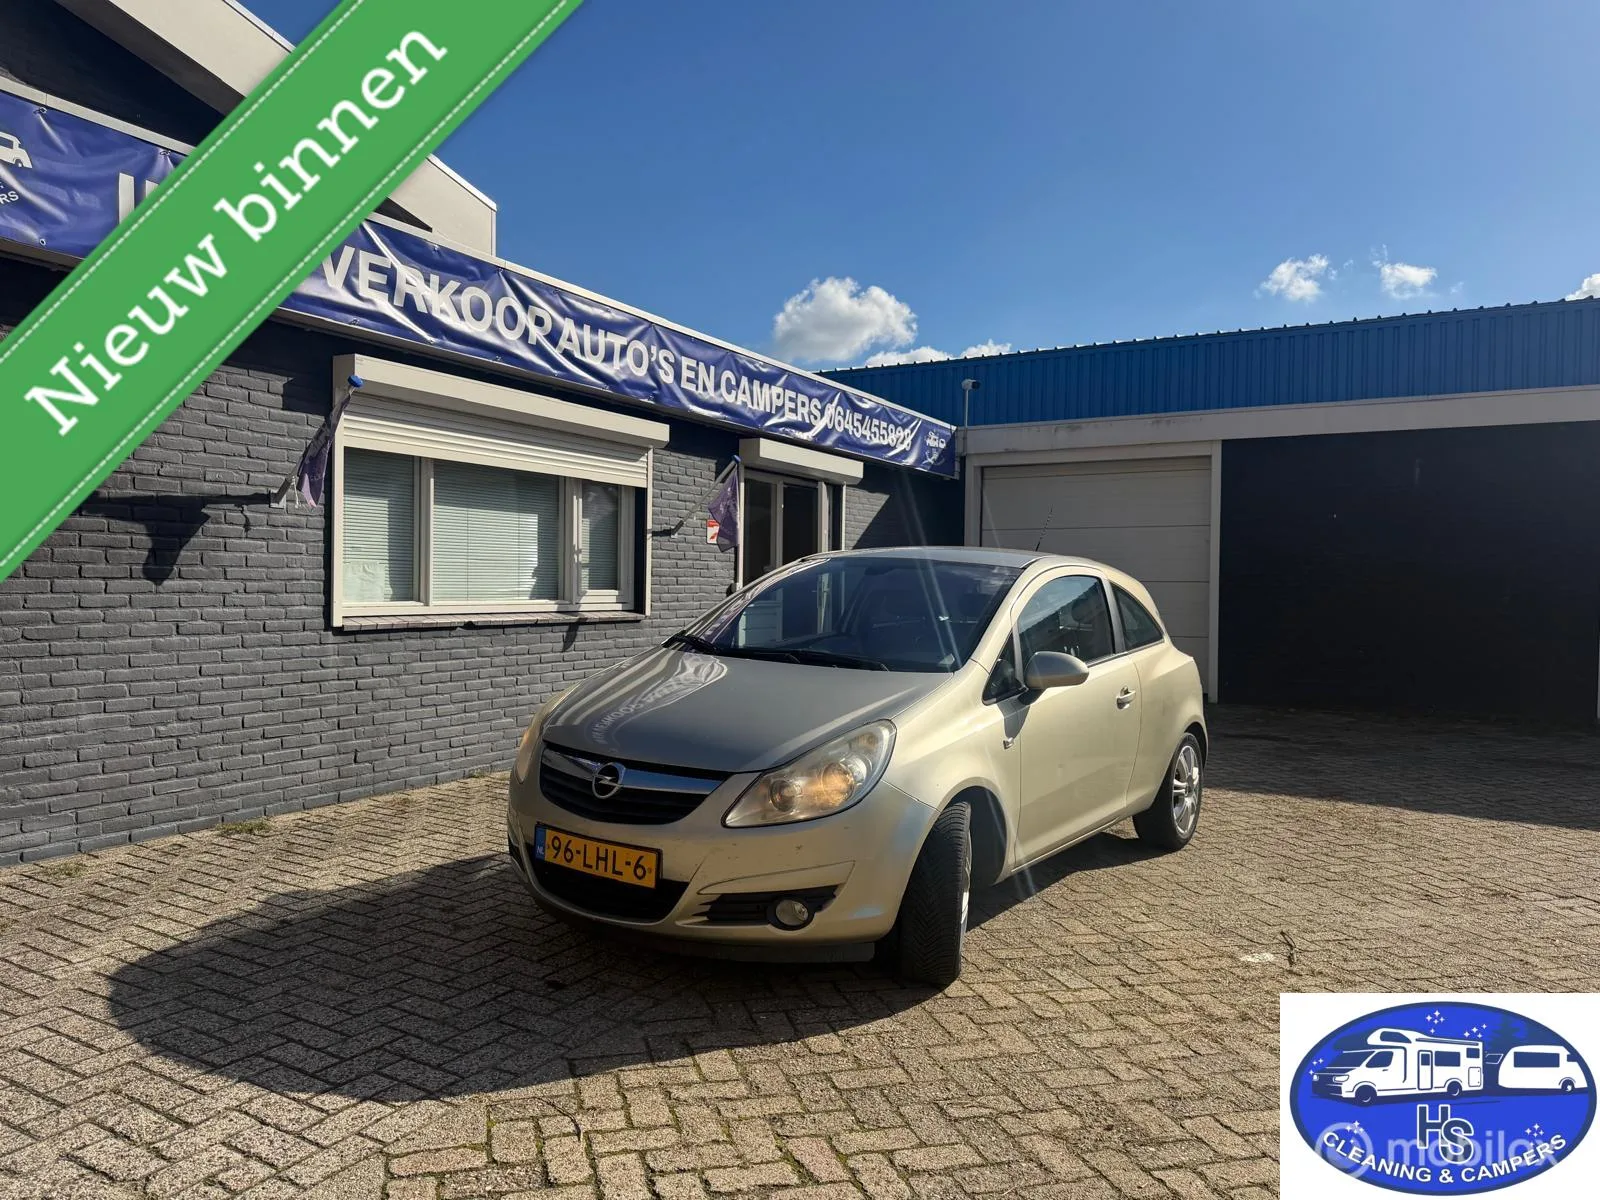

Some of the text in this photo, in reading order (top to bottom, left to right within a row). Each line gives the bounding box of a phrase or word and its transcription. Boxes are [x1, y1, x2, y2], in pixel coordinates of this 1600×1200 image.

[321, 245, 552, 345] VERKOOP
[556, 318, 676, 384] AUTO'S
[681, 355, 714, 396] EN
[720, 370, 822, 426] CAMPERS
[551, 835, 647, 880] 96-LHL-6
